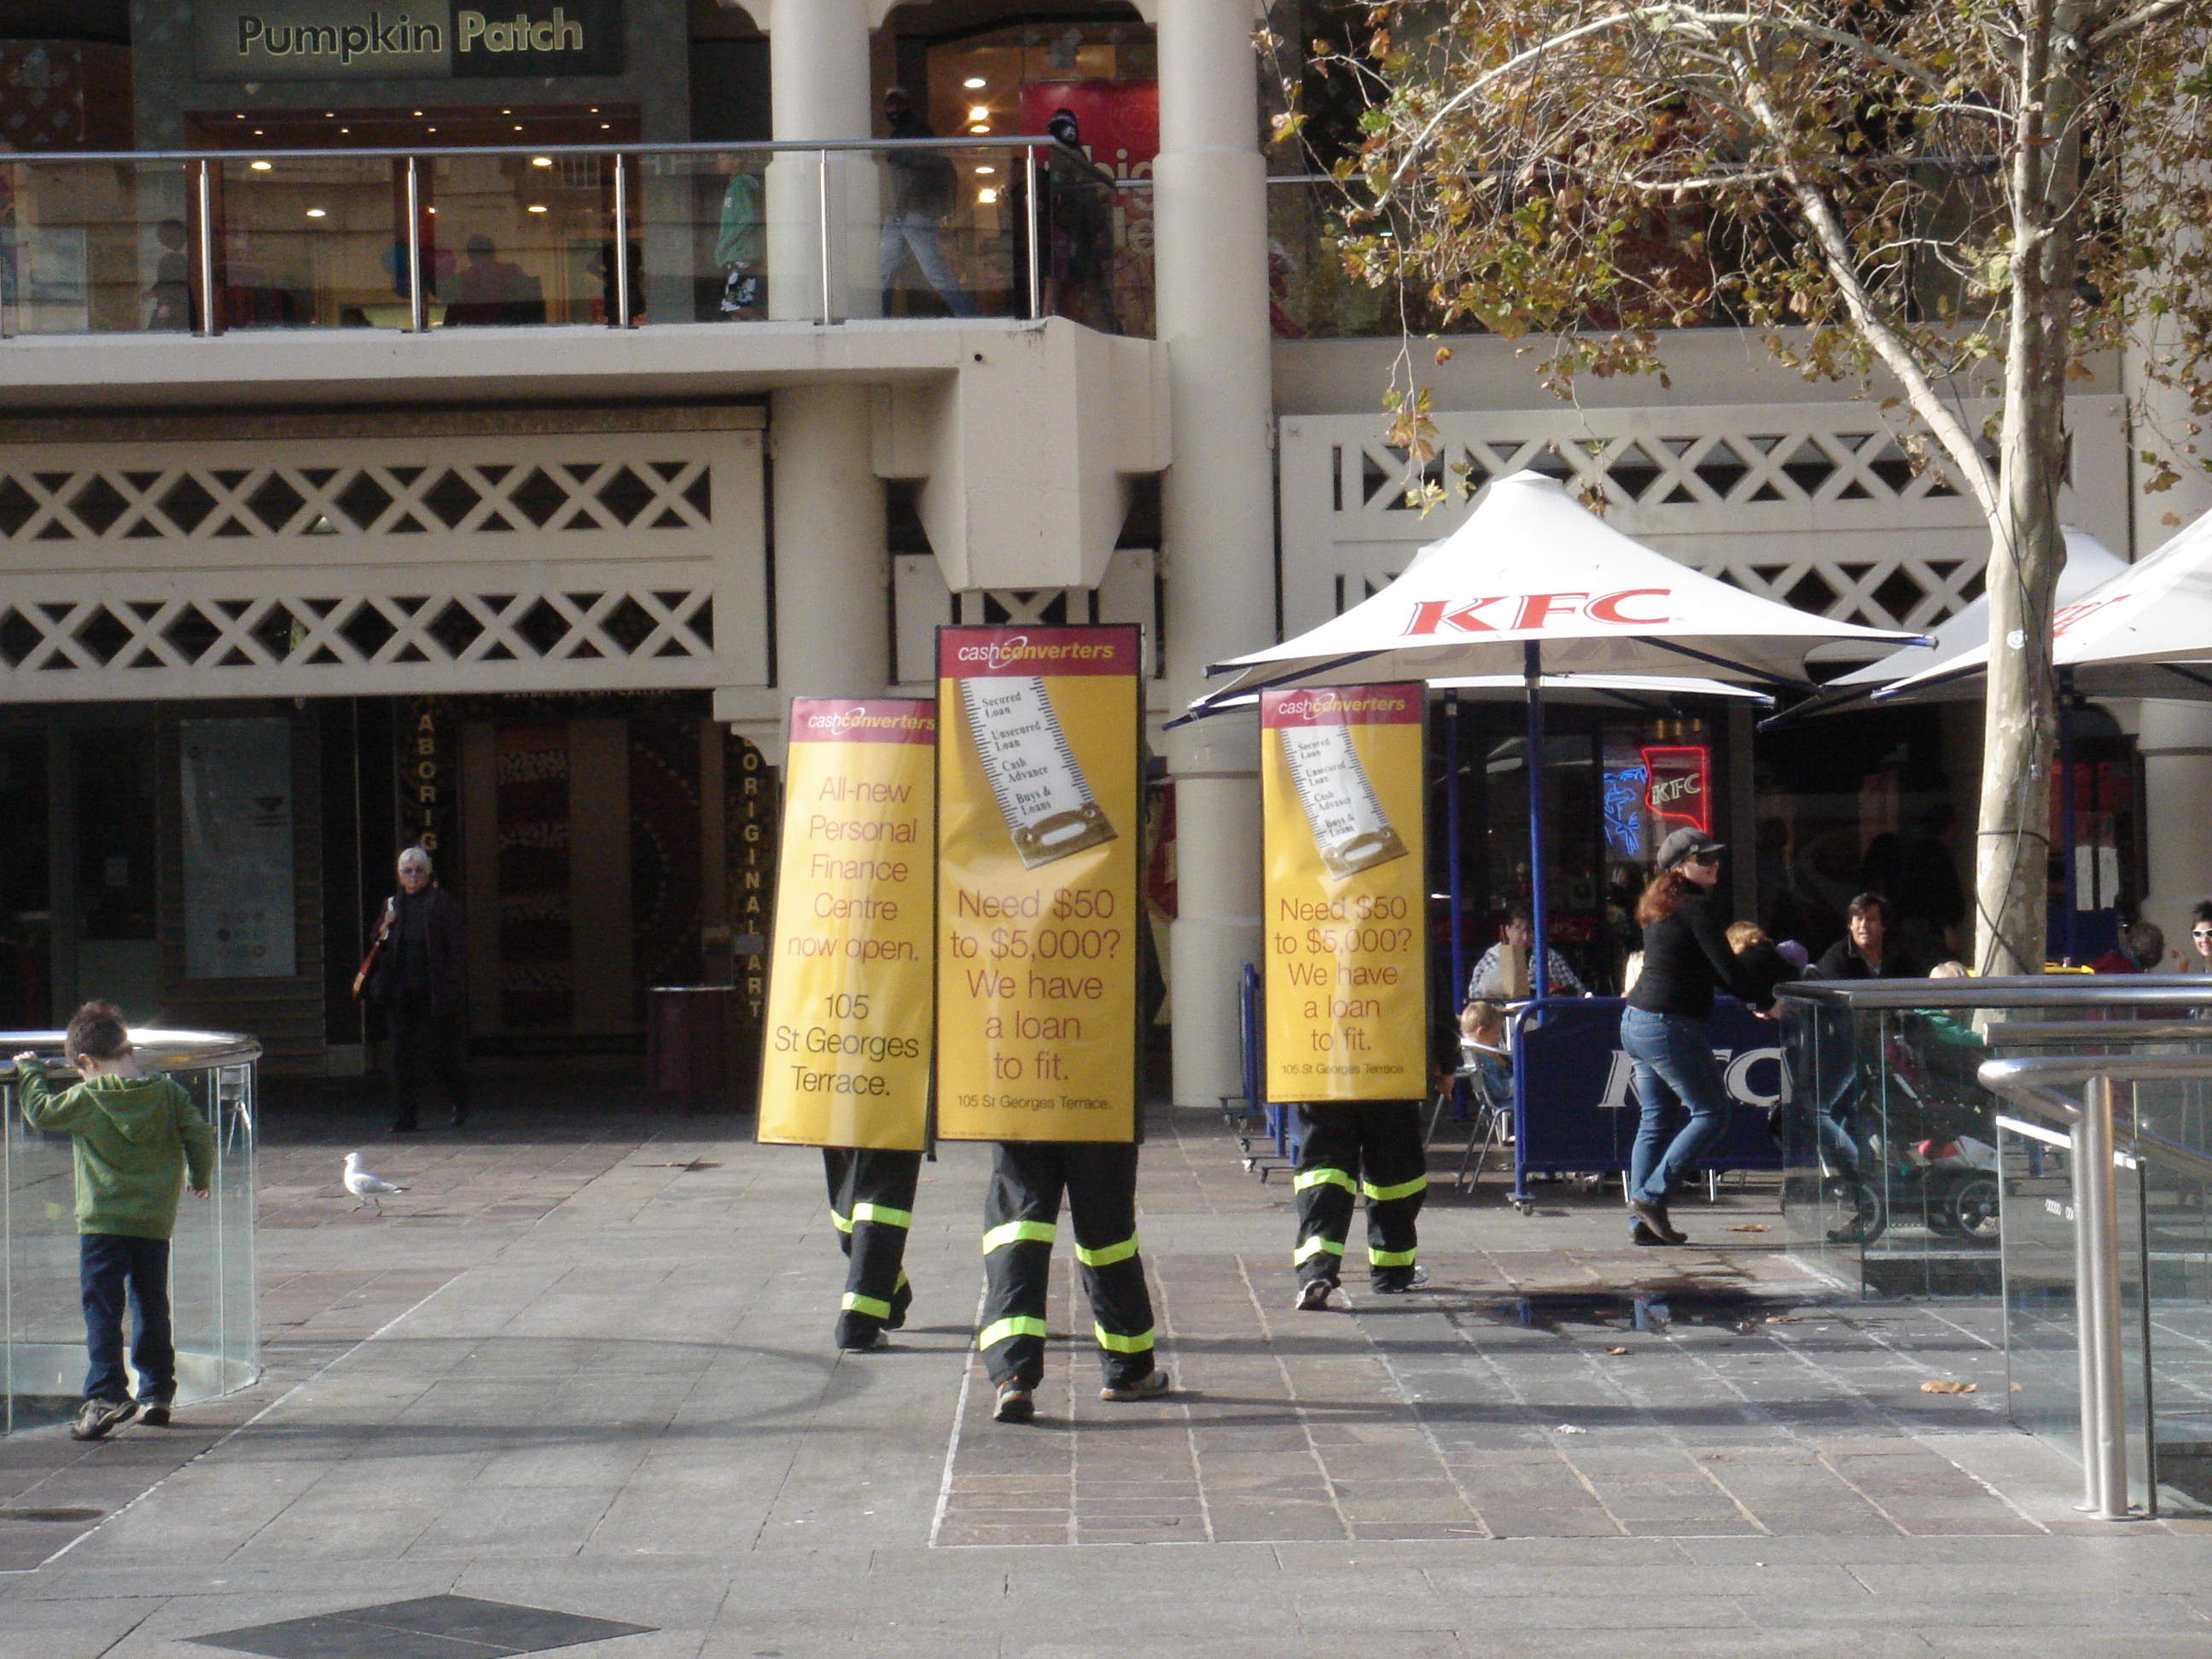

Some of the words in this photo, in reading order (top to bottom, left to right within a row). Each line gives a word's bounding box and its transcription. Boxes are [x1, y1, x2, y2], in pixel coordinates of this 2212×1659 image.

[237, 11, 443, 65] Pumpkin
[457, 6, 584, 52] Patch
[1398, 588, 1672, 637] KFC
[982, 691, 1022, 707] Secured
[985, 707, 1010, 718] Loan
[991, 721, 1041, 741] Unsecured
[995, 739, 1021, 752] Loan
[1002, 758, 1027, 771] Cash
[1009, 765, 1048, 783] Advance
[819, 777, 911, 803] All-new
[1016, 790, 1041, 805] Buys
[1044, 786, 1051, 796] &
[1651, 772, 1702, 805] KFC
[1021, 801, 1051, 816] Loans
[810, 815, 917, 843] Personal
[811, 853, 908, 882] Finance
[814, 892, 897, 921] Centre
[958, 888, 1039, 917] Need
[1053, 887, 1115, 921] $50
[1281, 898, 1345, 921] Need
[1357, 895, 1406, 921] $50
[788, 937, 838, 957] now
[845, 938, 919, 964] open.
[951, 930, 978, 958] to
[991, 927, 1121, 963] $5,000?
[1275, 932, 1296, 954] to
[1307, 927, 1412, 956] $5,000?
[747, 953, 762, 1017] ART
[966, 969, 1016, 999] We
[1028, 969, 1103, 999] have
[1289, 963, 1327, 986] We
[1338, 963, 1398, 985] have
[826, 993, 869, 1020] 105
[1304, 1000, 1318, 1019] a
[1328, 996, 1380, 1018] loan
[985, 1016, 1003, 1039] a
[1016, 1010, 1080, 1039] loan
[774, 1025, 800, 1052] St
[806, 1027, 919, 1062] Georges
[1312, 1029, 1334, 1051] to
[1343, 1027, 1371, 1051] fit.
[994, 1052, 1022, 1080] to
[1035, 1051, 1068, 1080] fit.
[1283, 1065, 1299, 1074] 105
[1302, 1064, 1313, 1074] St
[1316, 1063, 1360, 1077] Georges
[1365, 1063, 1406, 1074] Terrace.
[1598, 1047, 1792, 1108] KC
[791, 1065, 891, 1096] Terrace.
[958, 1095, 978, 1107] 105
[982, 1096, 995, 1108] St
[1000, 1095, 1055, 1111] Georges
[1061, 1096, 1111, 1109] Terrace.
